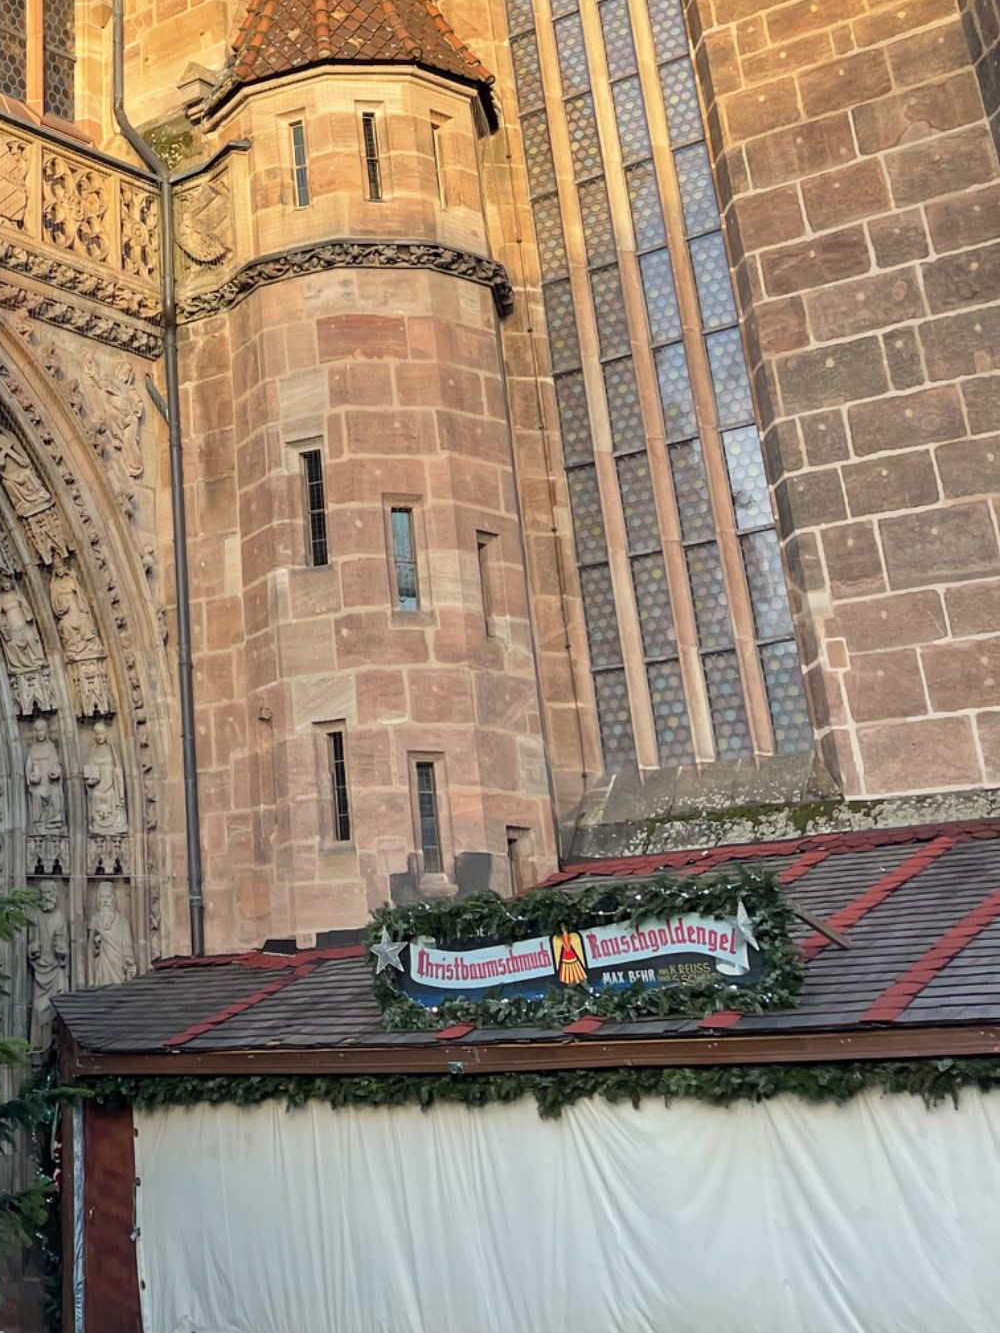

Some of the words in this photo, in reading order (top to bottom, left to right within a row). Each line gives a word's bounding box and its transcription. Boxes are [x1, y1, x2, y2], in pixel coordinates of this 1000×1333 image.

[586, 917, 737, 961] Rauschgoldengel
[417, 941, 553, 981] Christbaumschmuck
[678, 962, 711, 975] REUSS
[602, 971, 625, 986] MAX
